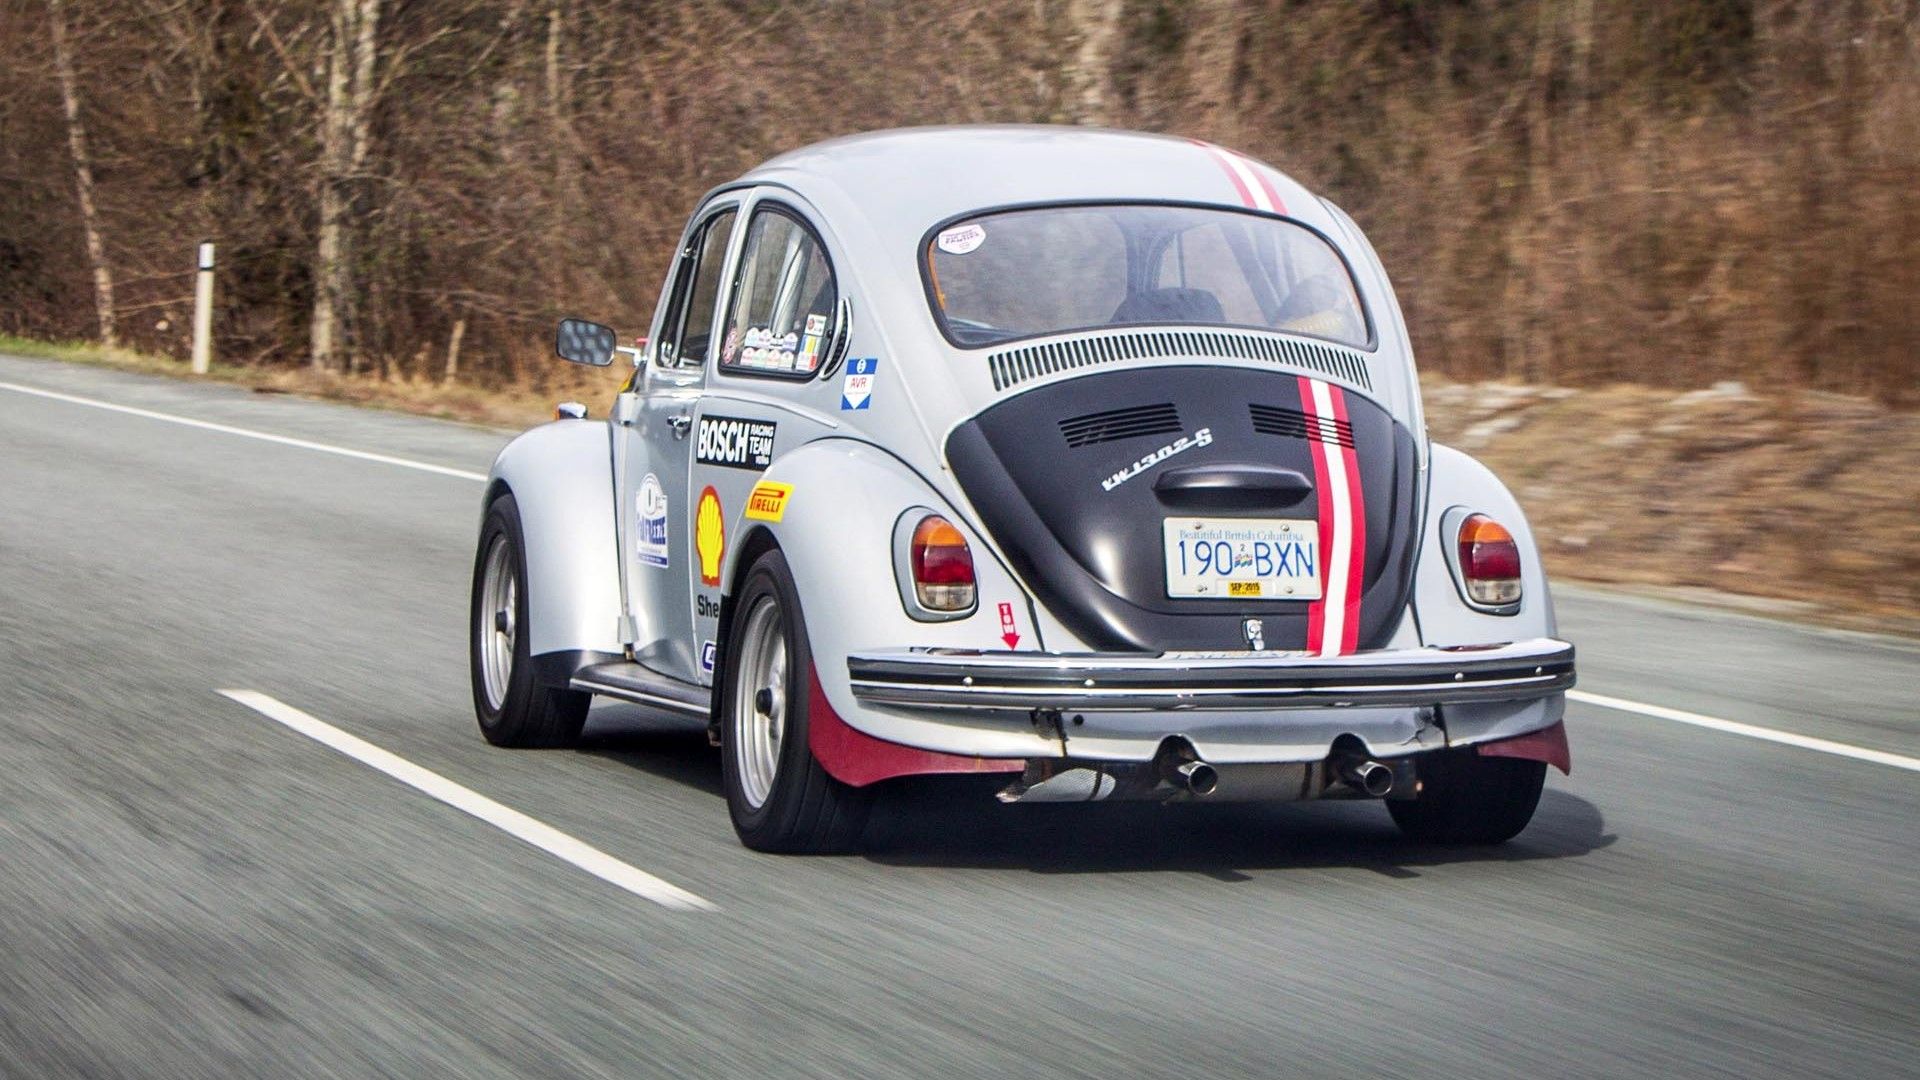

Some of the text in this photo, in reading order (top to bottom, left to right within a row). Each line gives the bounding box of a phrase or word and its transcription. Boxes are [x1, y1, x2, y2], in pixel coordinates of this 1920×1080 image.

[850, 377, 867, 389] AVR
[697, 419, 751, 463] BOSCH
[750, 424, 775, 437] RACING
[749, 436, 773, 456] TEAM
[749, 487, 785, 513] PIRELLI
[1179, 529, 1304, 541] Beautiful British Columbia
[1178, 540, 1315, 577] 190 BXN
[697, 594, 719, 618] She
[999, 604, 1016, 634] TOW
